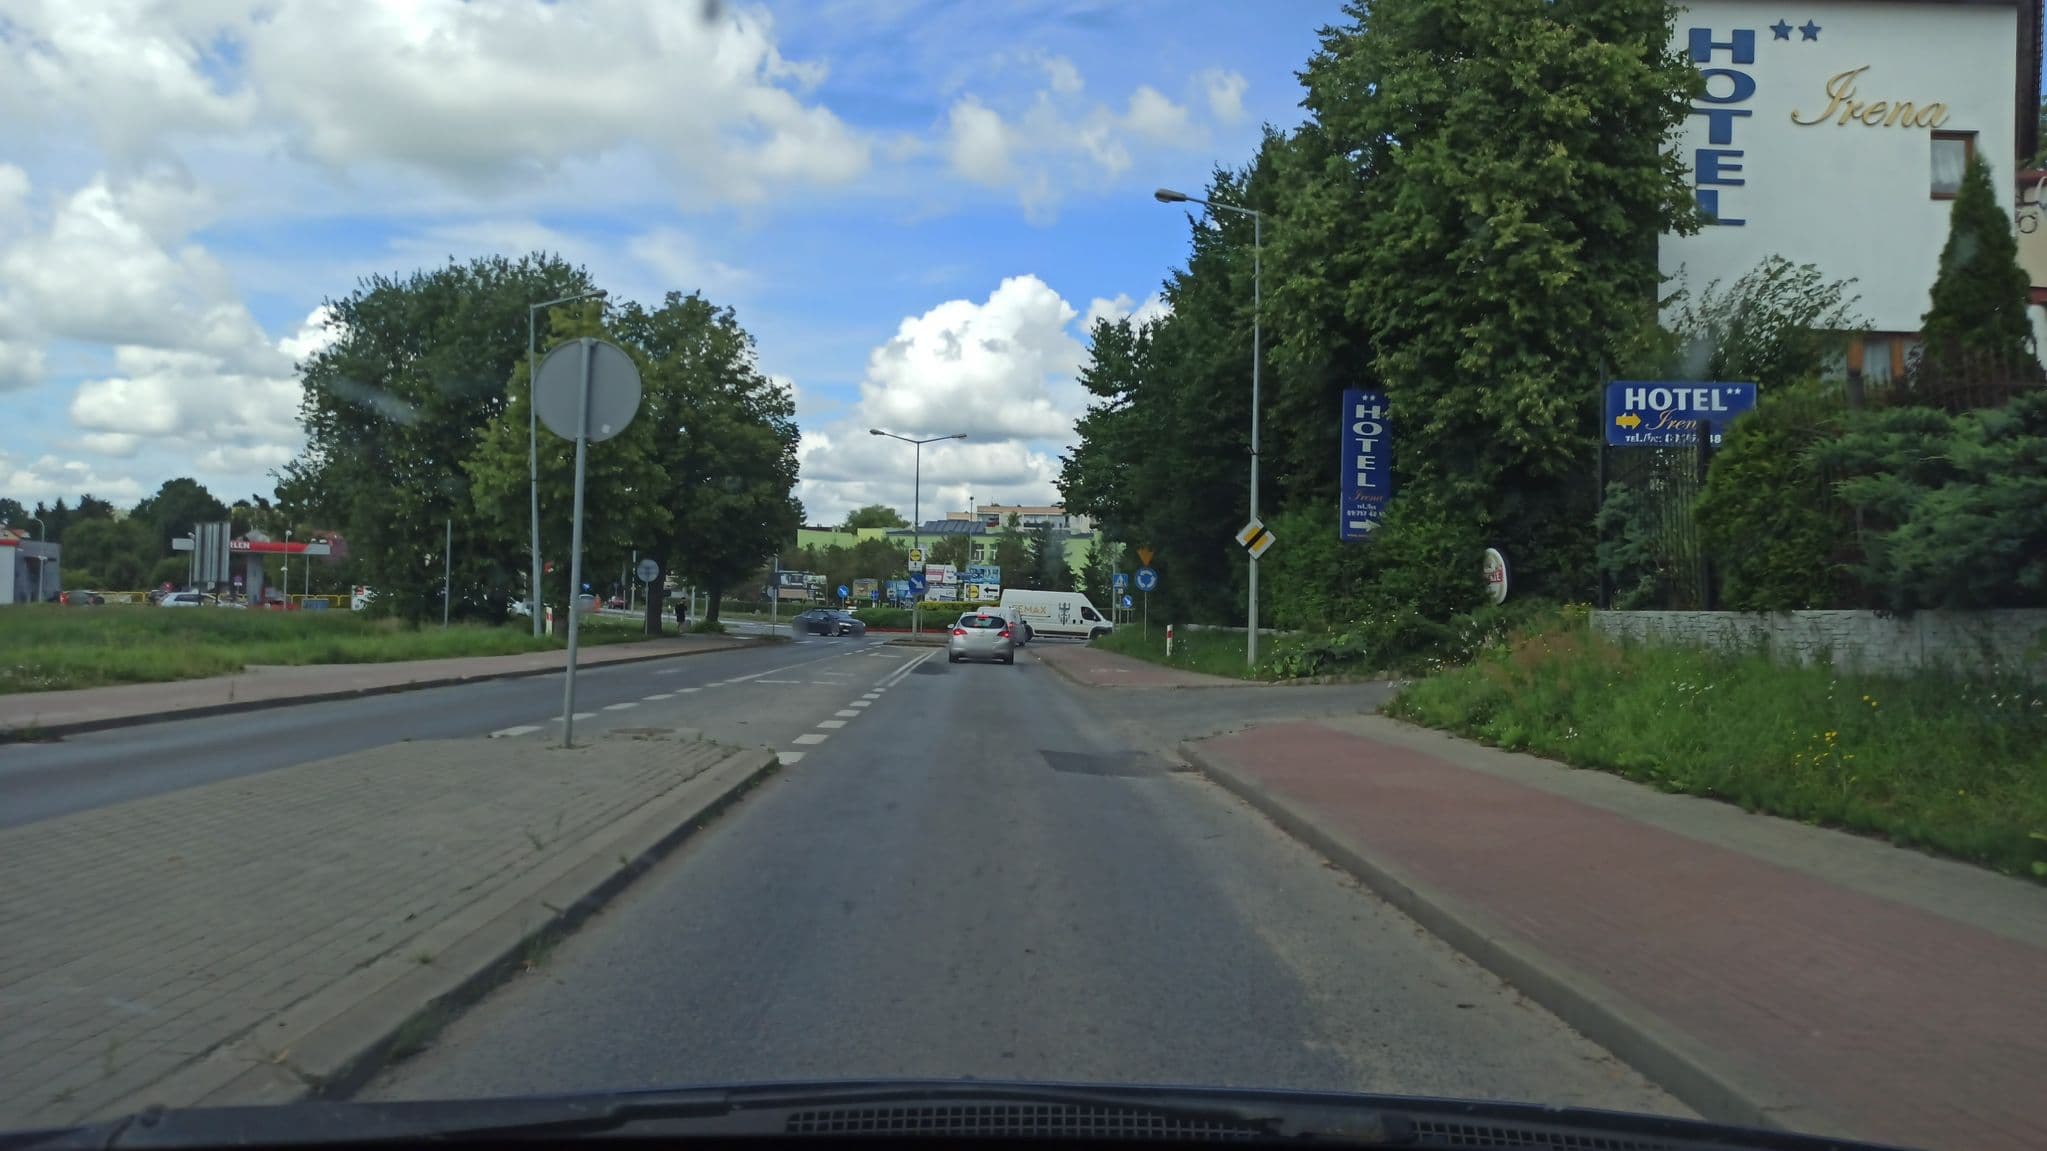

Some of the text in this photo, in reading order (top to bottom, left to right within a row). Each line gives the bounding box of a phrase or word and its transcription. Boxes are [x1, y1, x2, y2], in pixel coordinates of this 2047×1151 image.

[1688, 28, 1756, 227] HOTEL
[1790, 64, 1950, 128] Irena
[1625, 388, 1728, 411] HOTEL
[1645, 408, 1697, 430] Iren
[1352, 404, 1383, 488] HOTEL
